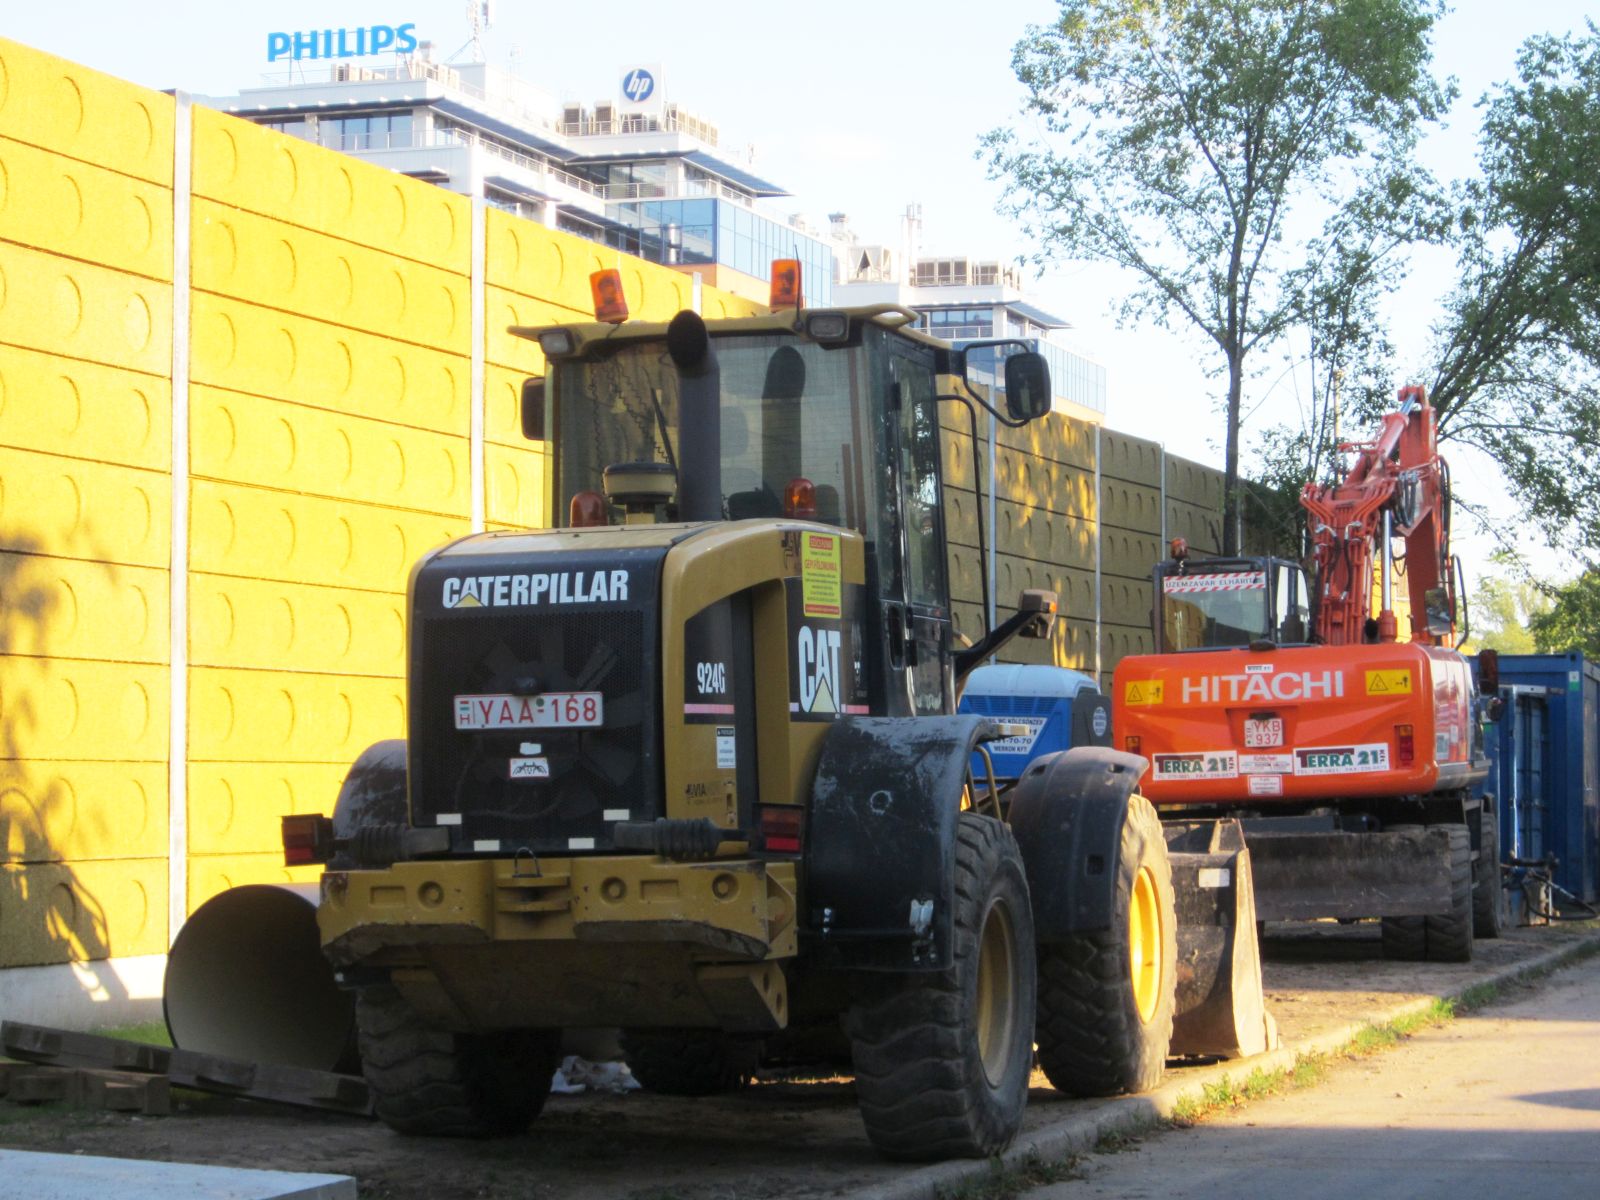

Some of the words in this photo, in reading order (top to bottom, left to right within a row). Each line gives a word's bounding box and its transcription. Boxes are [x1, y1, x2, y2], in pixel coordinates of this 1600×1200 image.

[268, 23, 417, 62] PHILIPS
[625, 69, 652, 101] hp
[442, 570, 629, 609] CATERPILLAR
[697, 662, 726, 694] 924G
[798, 625, 840, 713] CAT
[1182, 671, 1344, 703] HITACHI
[1254, 720, 1281, 732] YKB
[1256, 733, 1279, 745] 937
[1155, 754, 1204, 773] TERRA
[1207, 757, 1228, 772] 21
[1296, 748, 1355, 768] TERRA
[1357, 750, 1379, 765] 21
